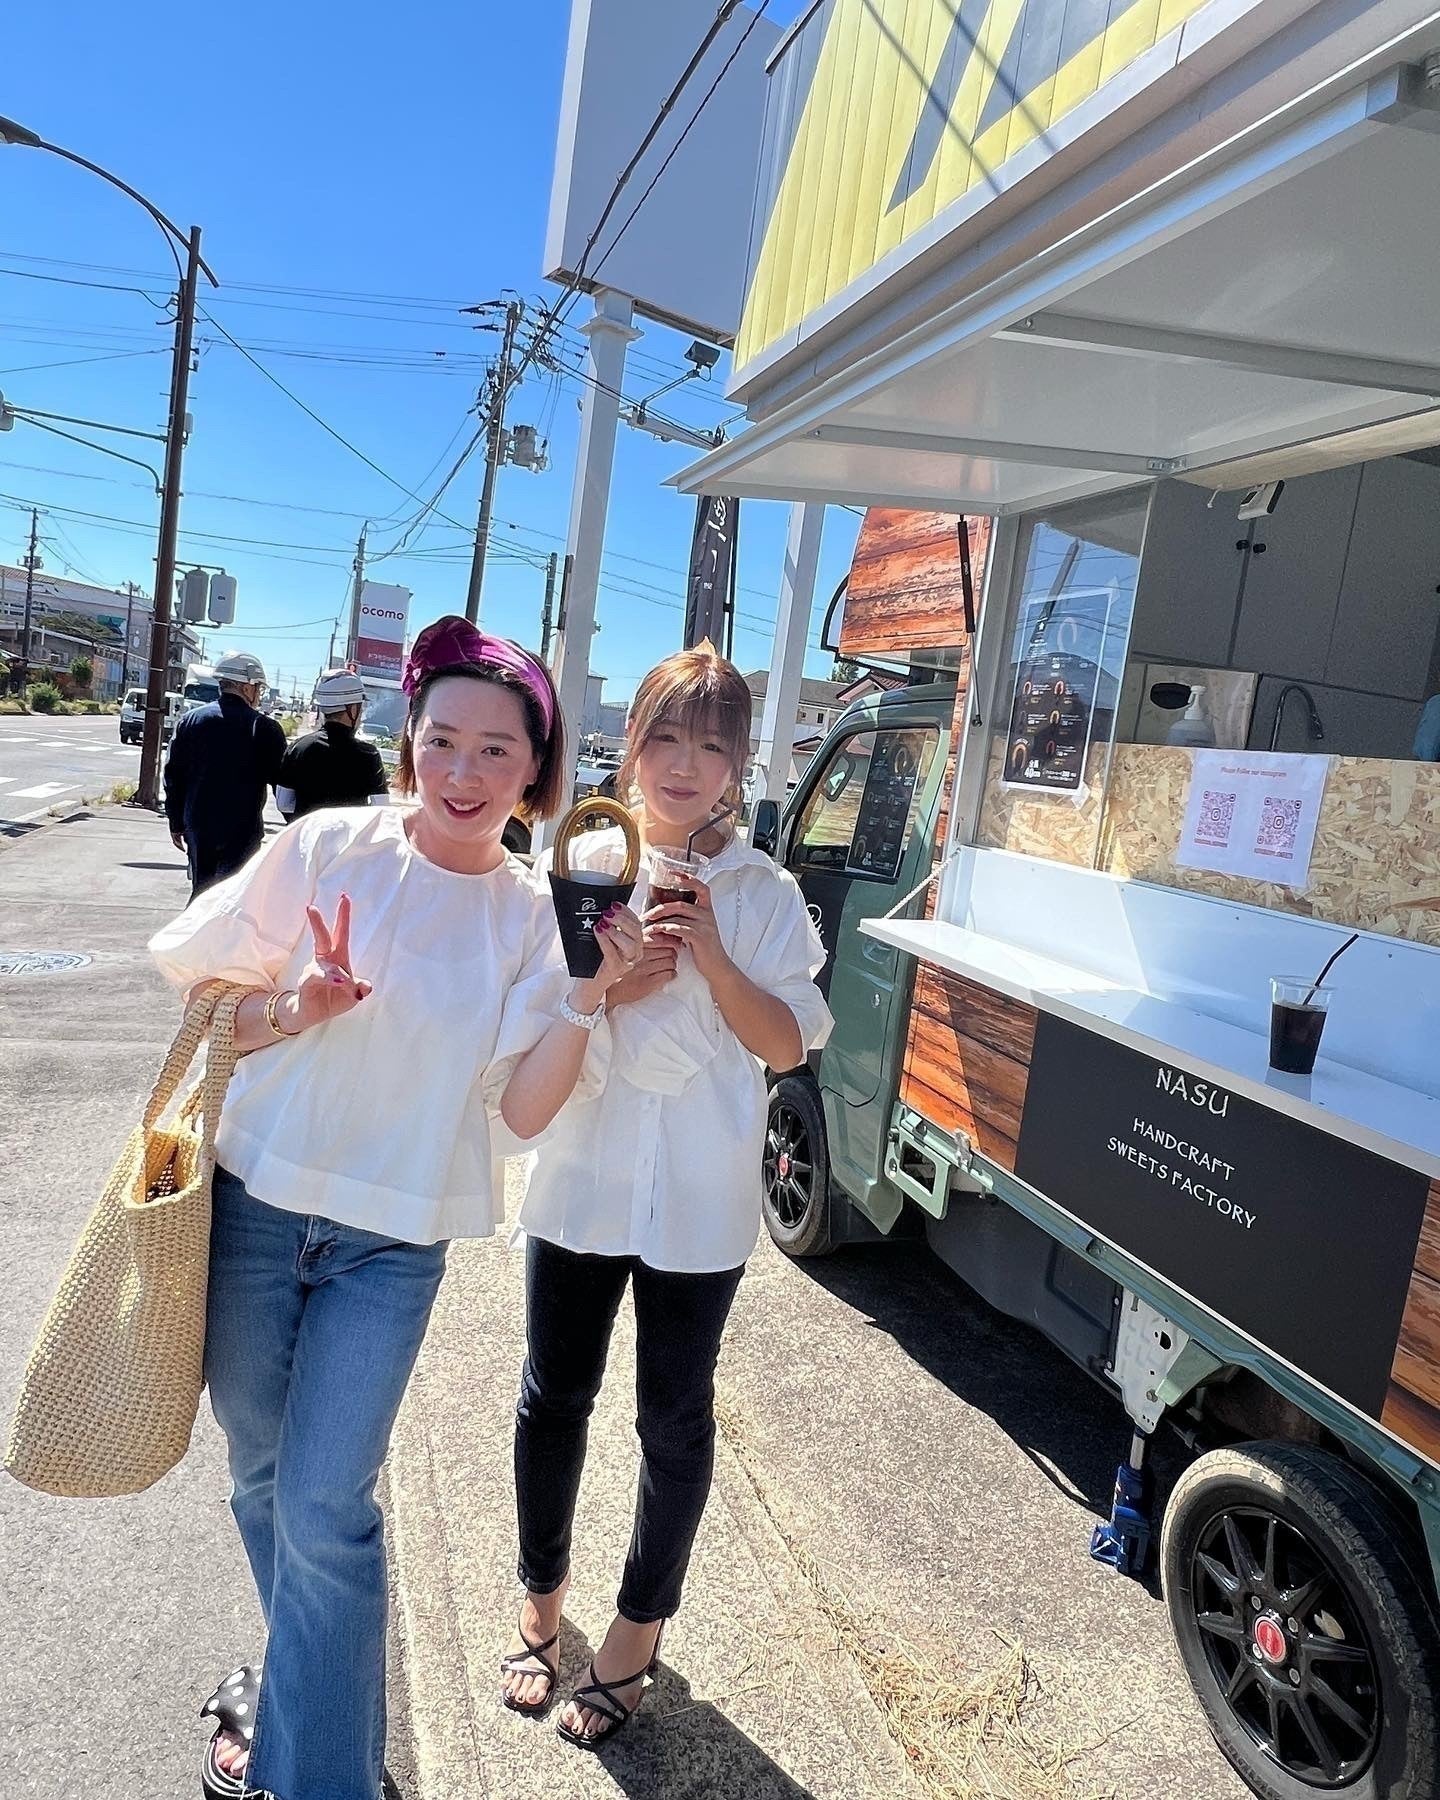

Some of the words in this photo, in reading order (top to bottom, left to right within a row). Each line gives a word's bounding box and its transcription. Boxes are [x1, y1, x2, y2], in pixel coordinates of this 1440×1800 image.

[361, 604, 405, 620] ocomo
[1155, 1067, 1229, 1118] NASU
[1133, 1117, 1235, 1181] HANDCRAFT
[1107, 1136, 1168, 1179] SWEETS
[1171, 1170, 1257, 1229] FACTORY
